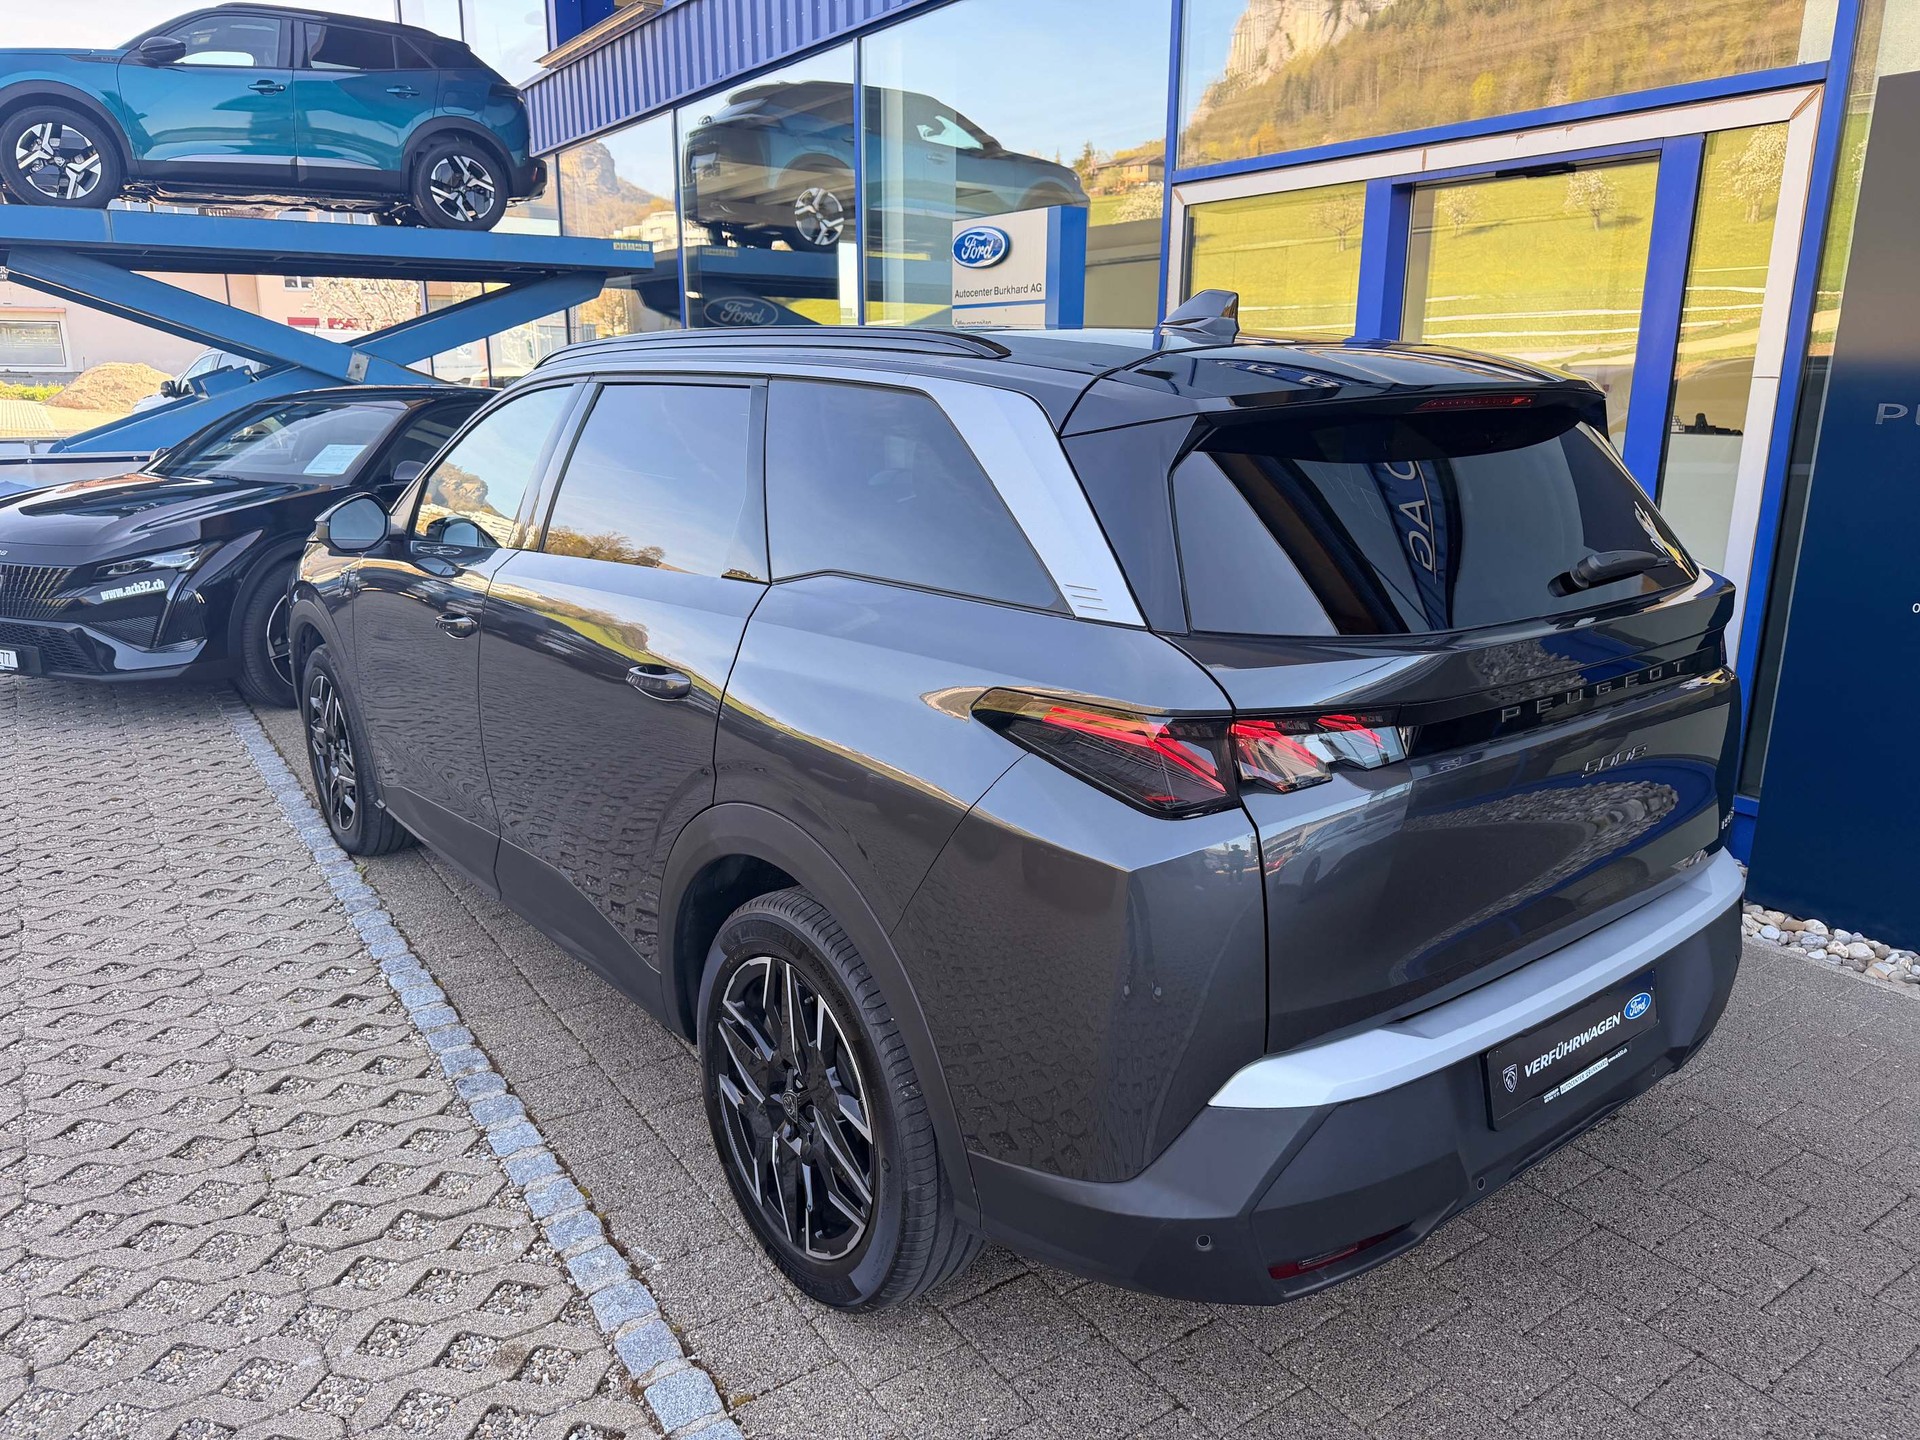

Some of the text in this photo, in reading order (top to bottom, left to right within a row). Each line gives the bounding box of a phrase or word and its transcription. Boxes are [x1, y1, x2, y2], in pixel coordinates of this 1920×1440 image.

[954, 282, 1042, 299] Autocenter Burkhard AG
[720, 300, 765, 324] Ford
[1875, 403, 1920, 425] P
[1501, 659, 1687, 724] PEUGEOT
[1524, 1011, 1621, 1078] VERFÜHRWAGEN
